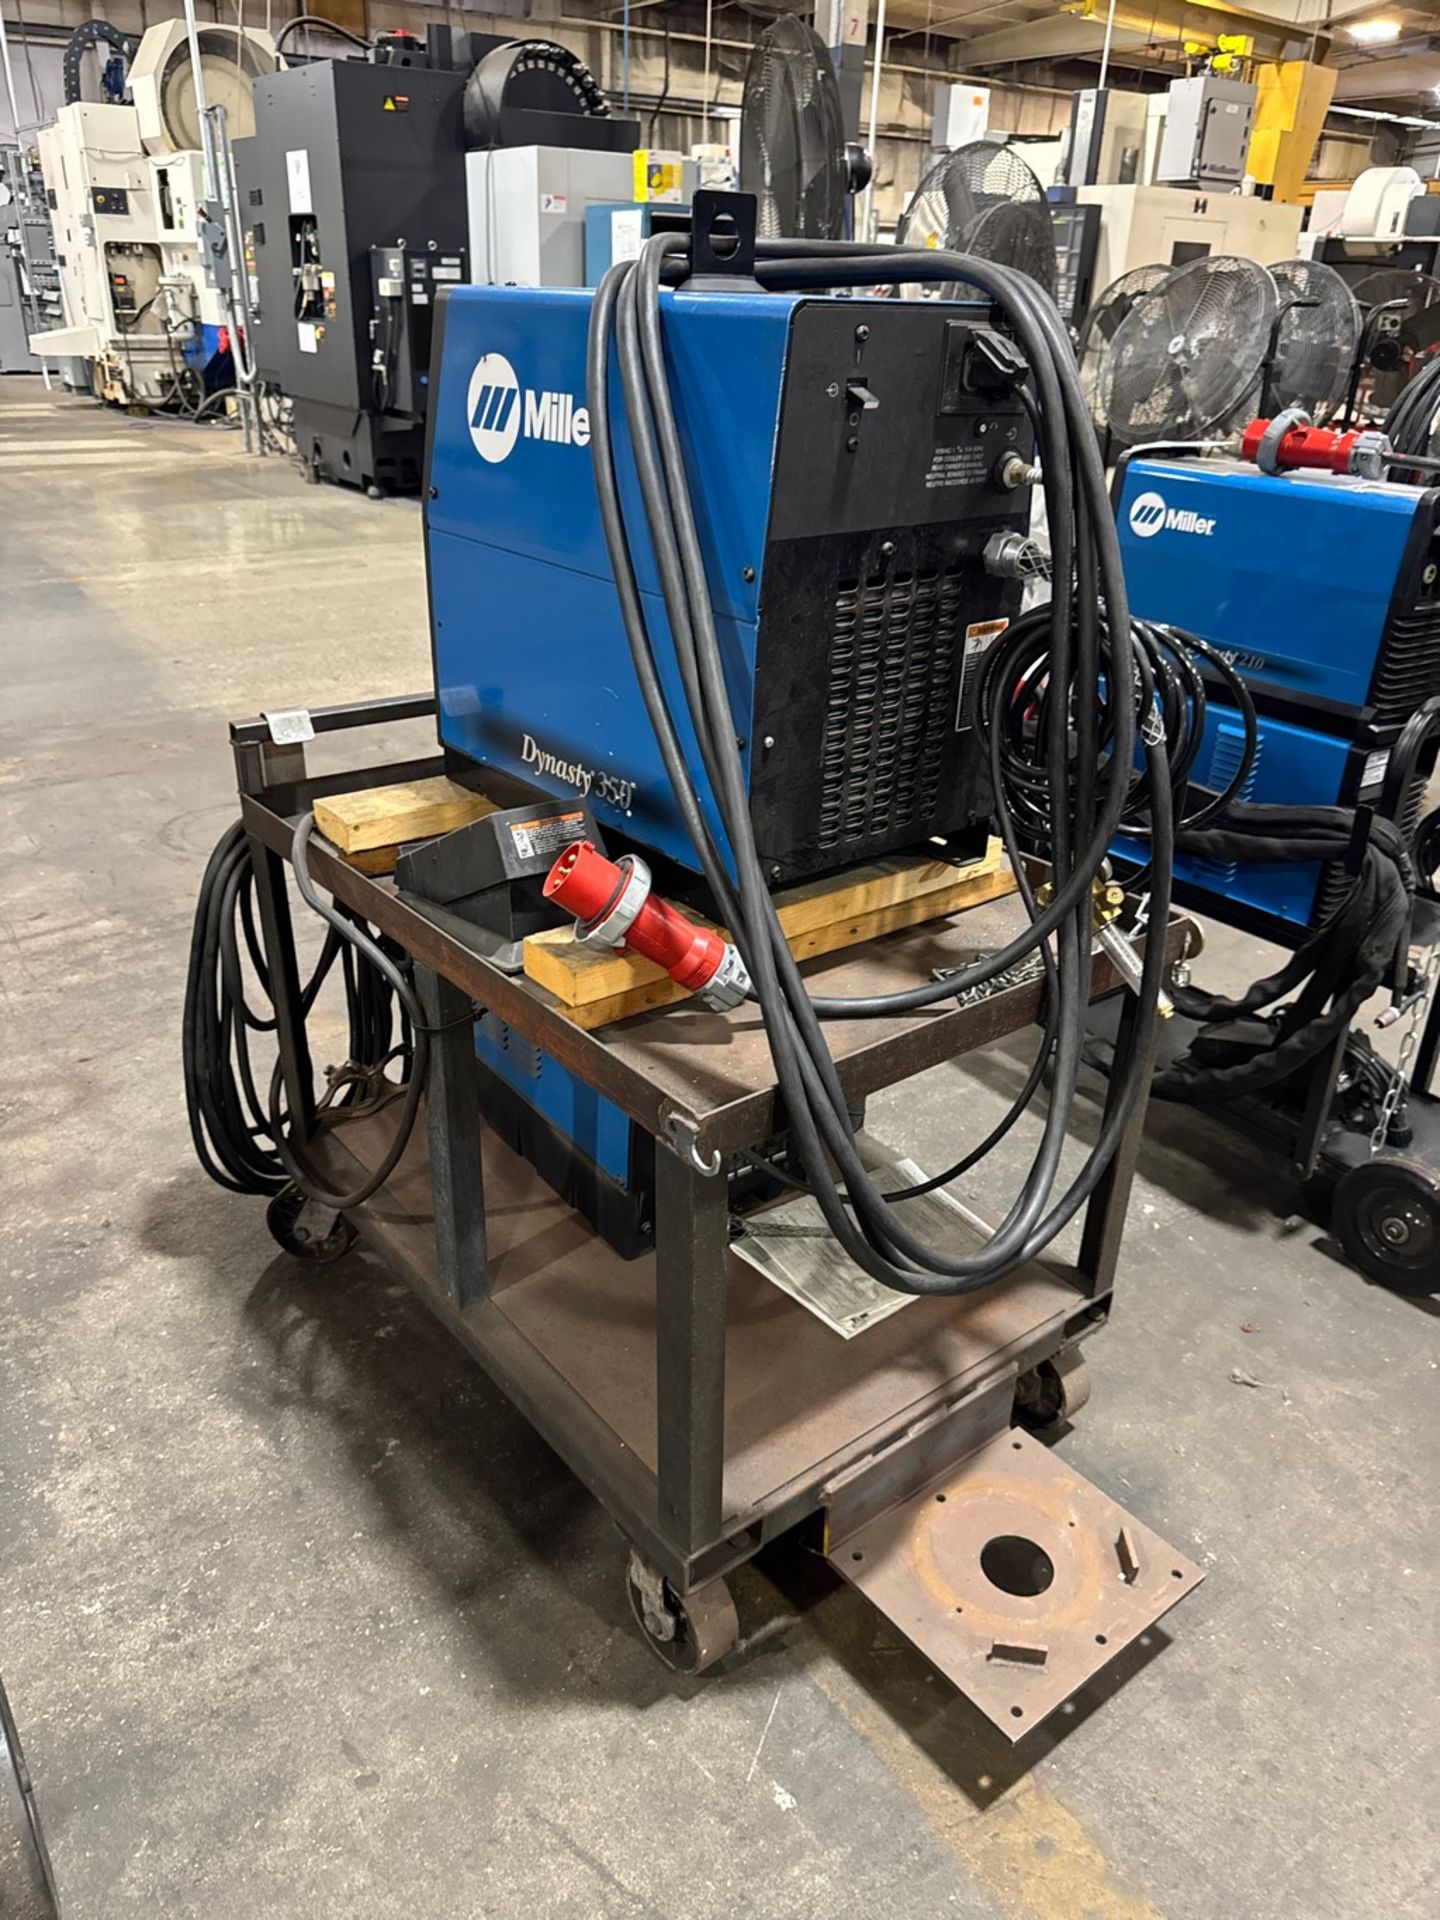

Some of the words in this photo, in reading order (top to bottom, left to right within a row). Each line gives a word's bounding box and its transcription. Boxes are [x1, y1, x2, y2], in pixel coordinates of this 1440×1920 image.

[850, 18, 859, 36] 7
[524, 389, 591, 447] Mille
[1165, 508, 1217, 537] Miller
[1239, 653, 1265, 671] 210
[595, 771, 632, 810] 350
